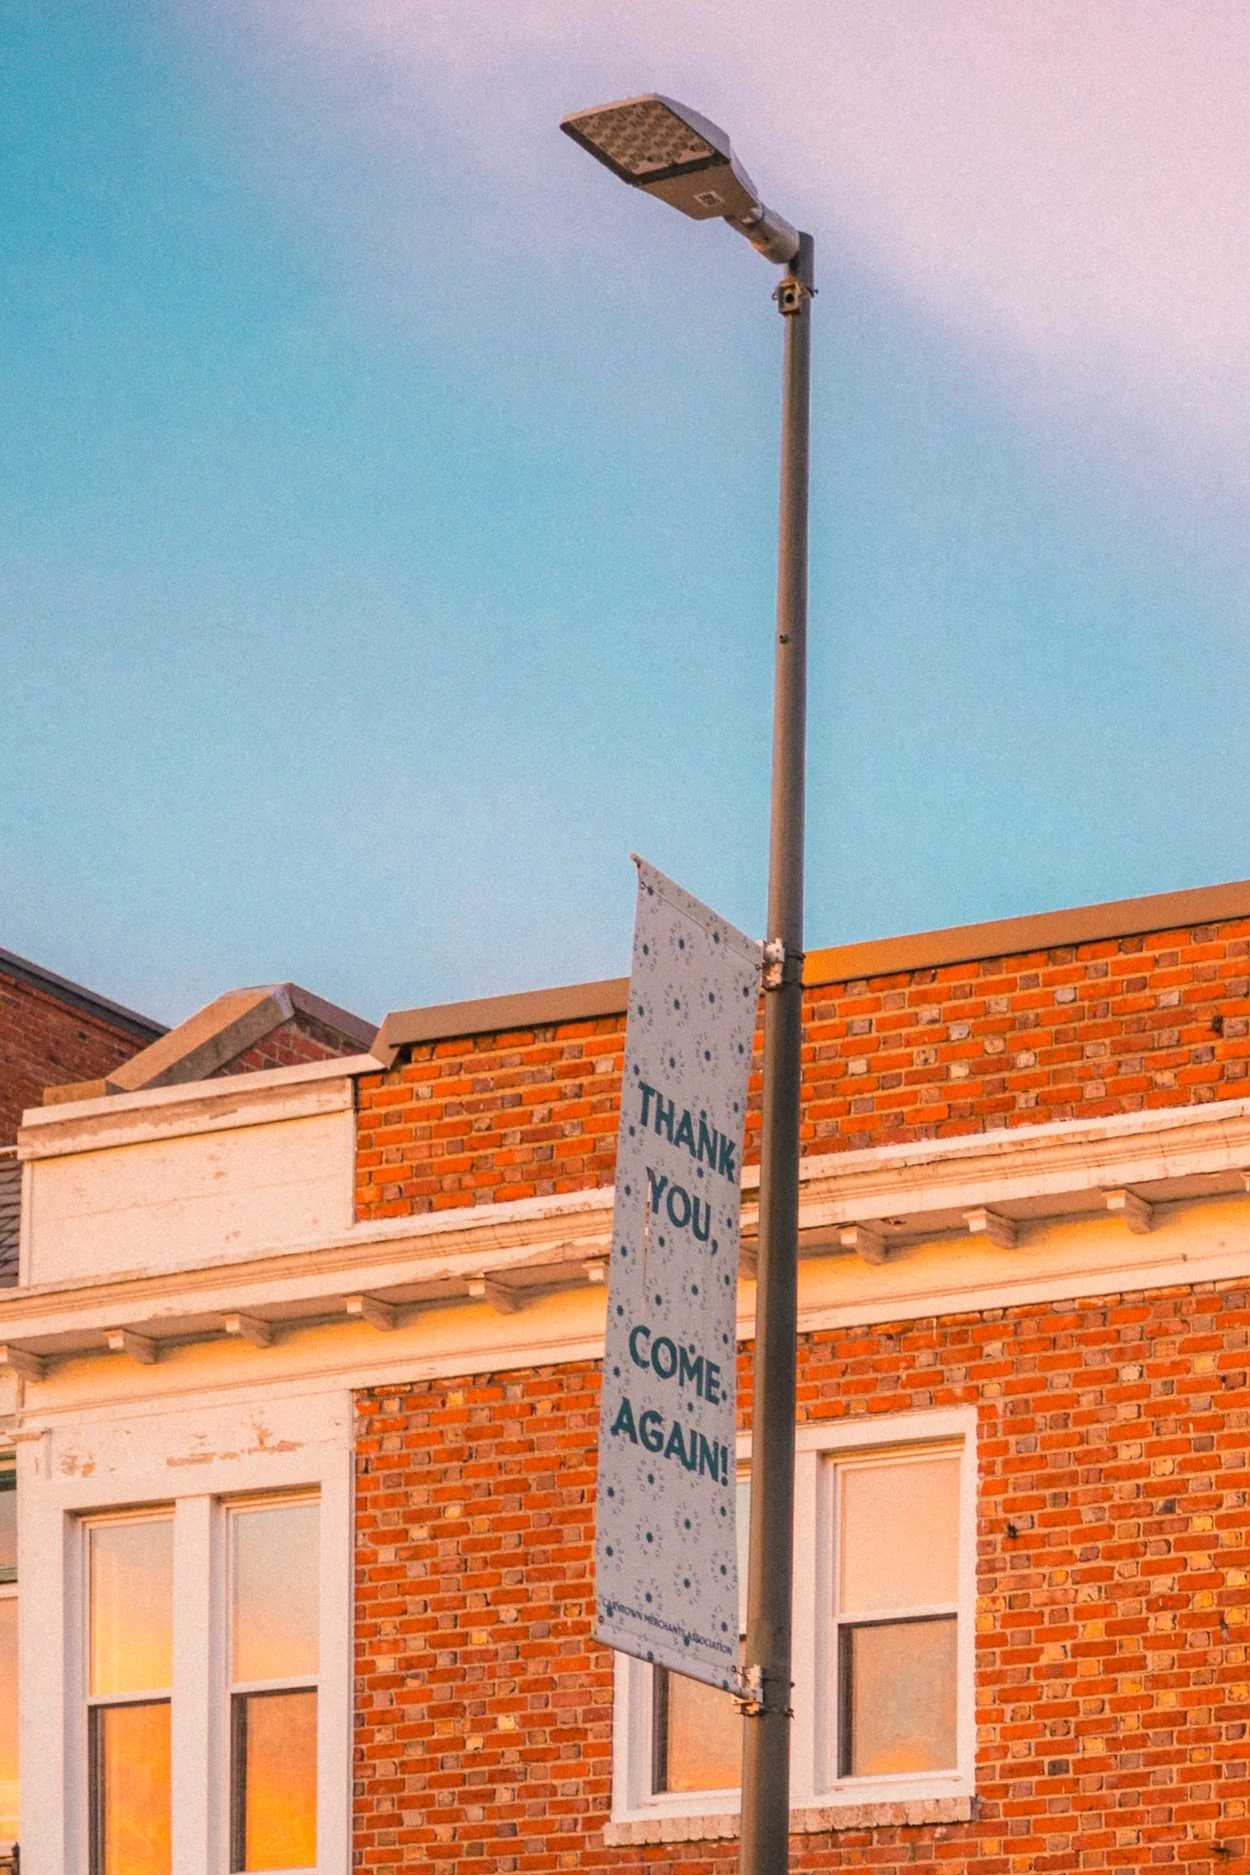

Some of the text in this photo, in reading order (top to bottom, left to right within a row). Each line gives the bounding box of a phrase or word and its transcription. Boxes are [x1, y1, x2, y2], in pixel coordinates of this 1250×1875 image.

[639, 1081, 736, 1183] THANK
[647, 1166, 718, 1255] YOU,
[629, 1325, 720, 1405] COME
[614, 1397, 729, 1486] AGAIN!
